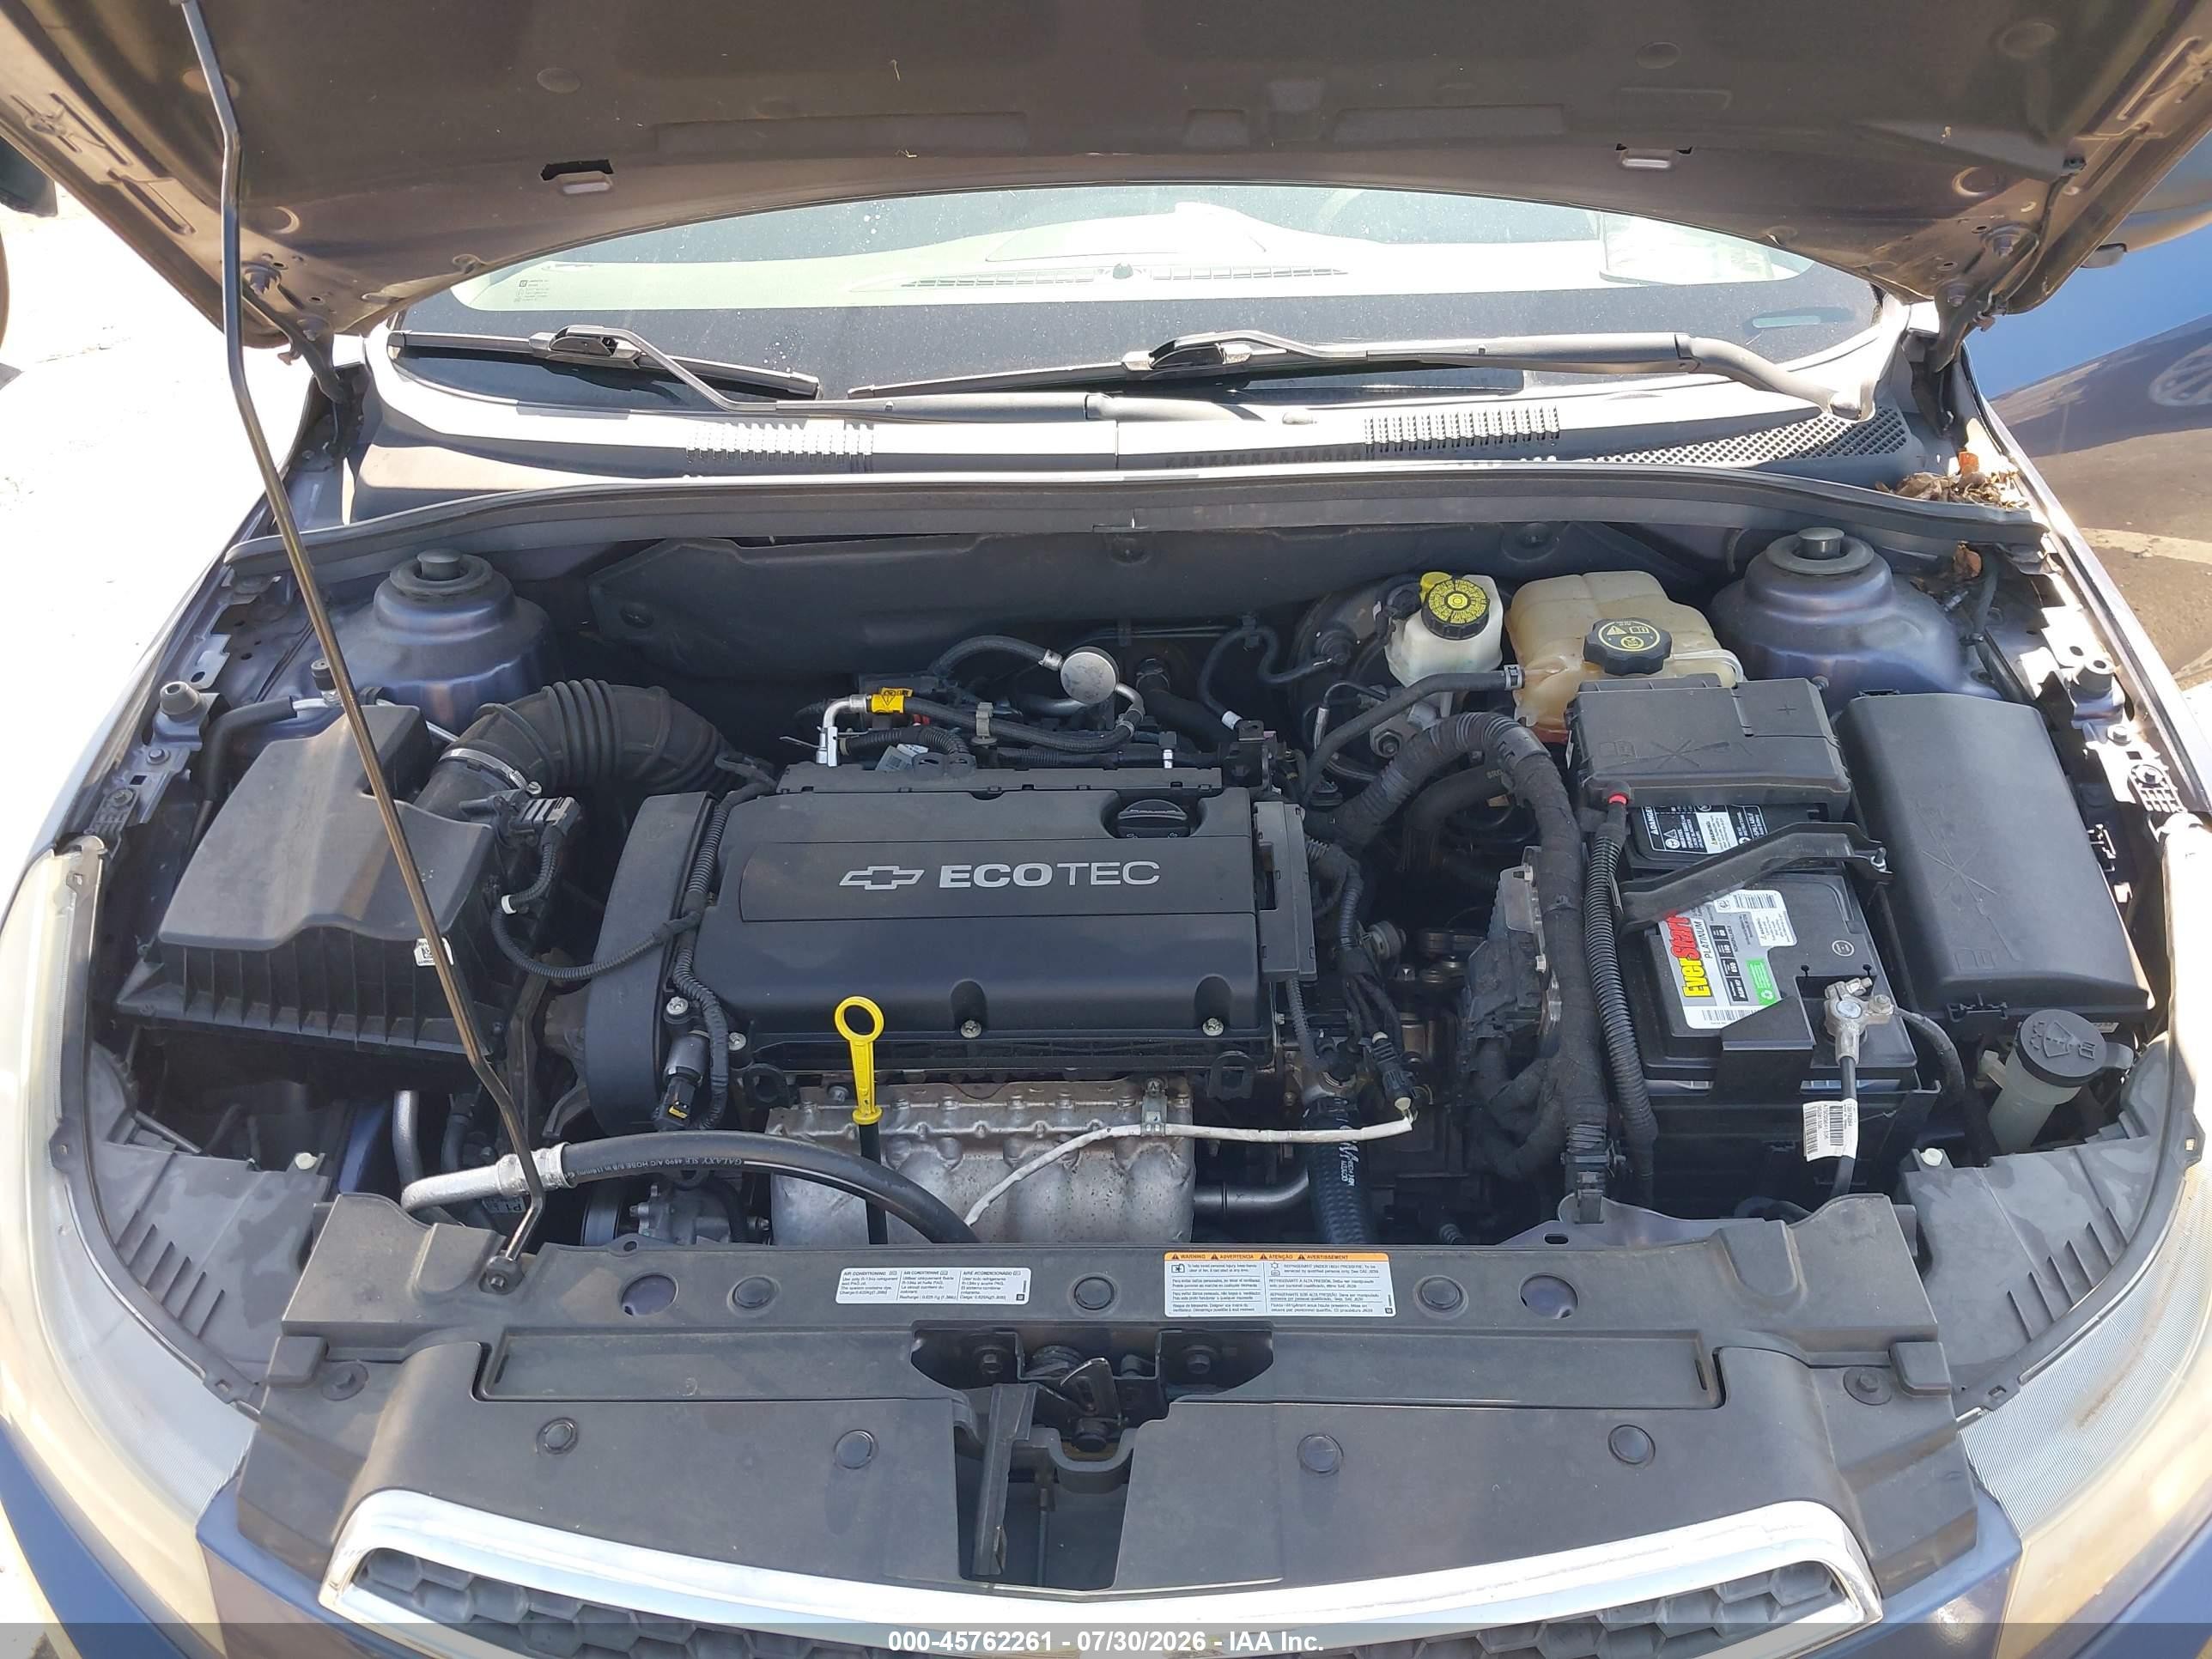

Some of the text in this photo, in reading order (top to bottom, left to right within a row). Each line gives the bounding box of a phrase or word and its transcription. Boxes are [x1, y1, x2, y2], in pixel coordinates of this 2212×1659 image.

[939, 860, 1160, 888] ECOTEC
[1693, 921, 1713, 960] PLATINUM
[702, 1157, 742, 1166] GALAXY
